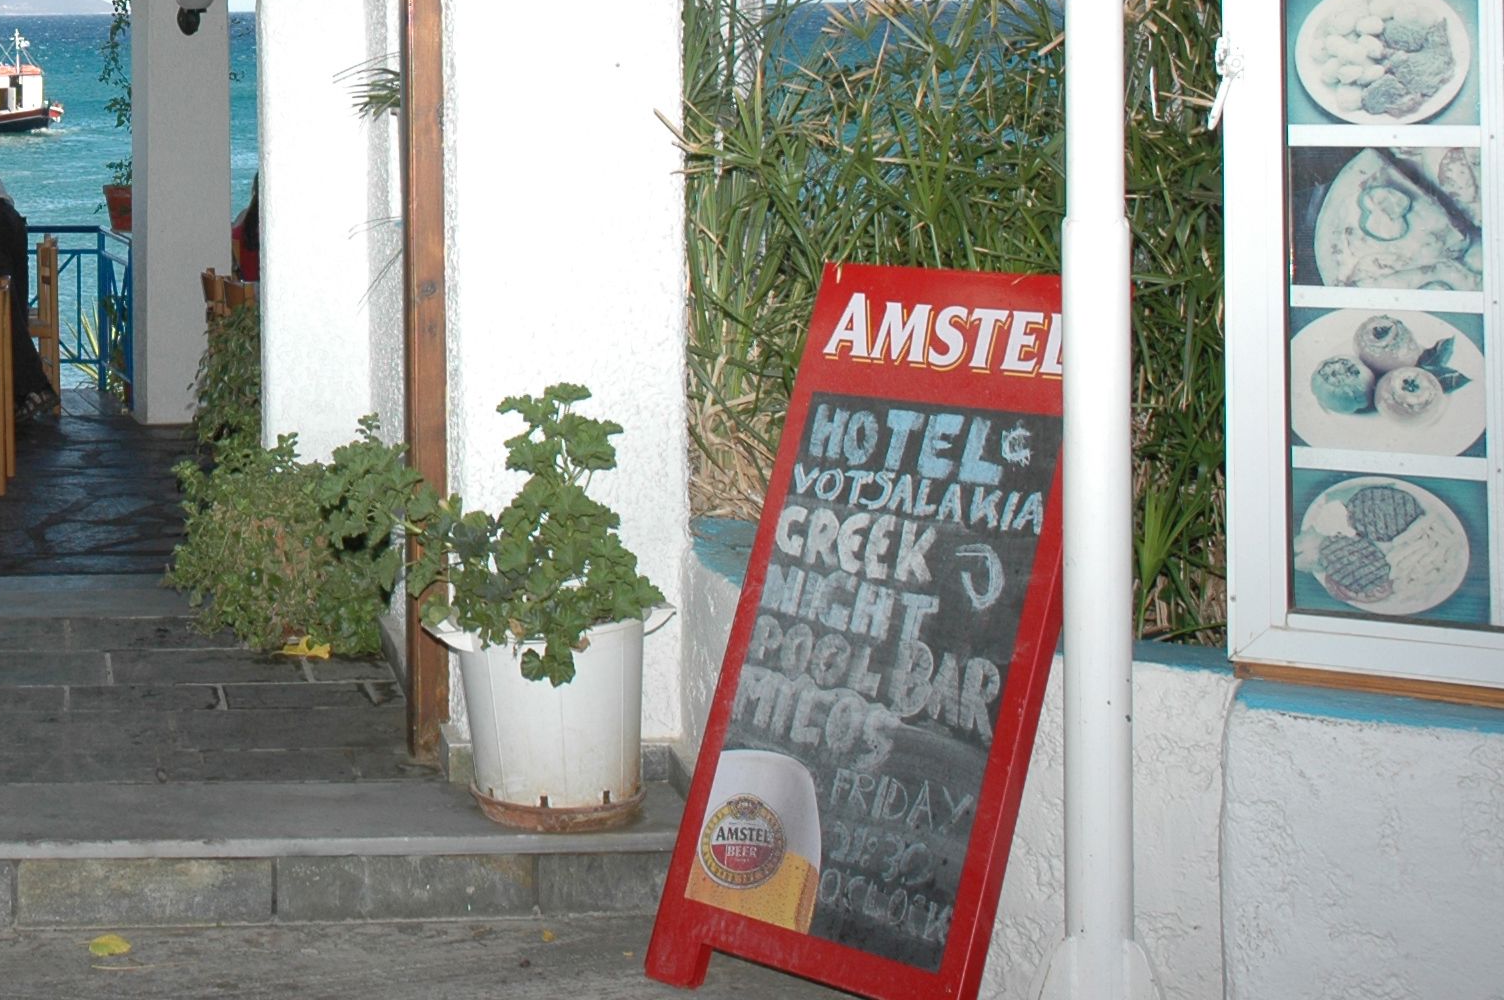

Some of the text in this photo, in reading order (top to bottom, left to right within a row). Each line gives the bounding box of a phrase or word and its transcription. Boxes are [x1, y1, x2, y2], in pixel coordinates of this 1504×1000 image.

[808, 403, 1004, 486] HOTEL
[793, 463, 1044, 536] VOTSALAKIA
[775, 505, 937, 584] GREEK
[760, 563, 940, 642] NIGHT
[749, 614, 1002, 746] POOL BAR
[716, 826, 772, 845] AMSTEL
[830, 767, 975, 835] FRIDAY
[725, 844, 758, 858] BEER
